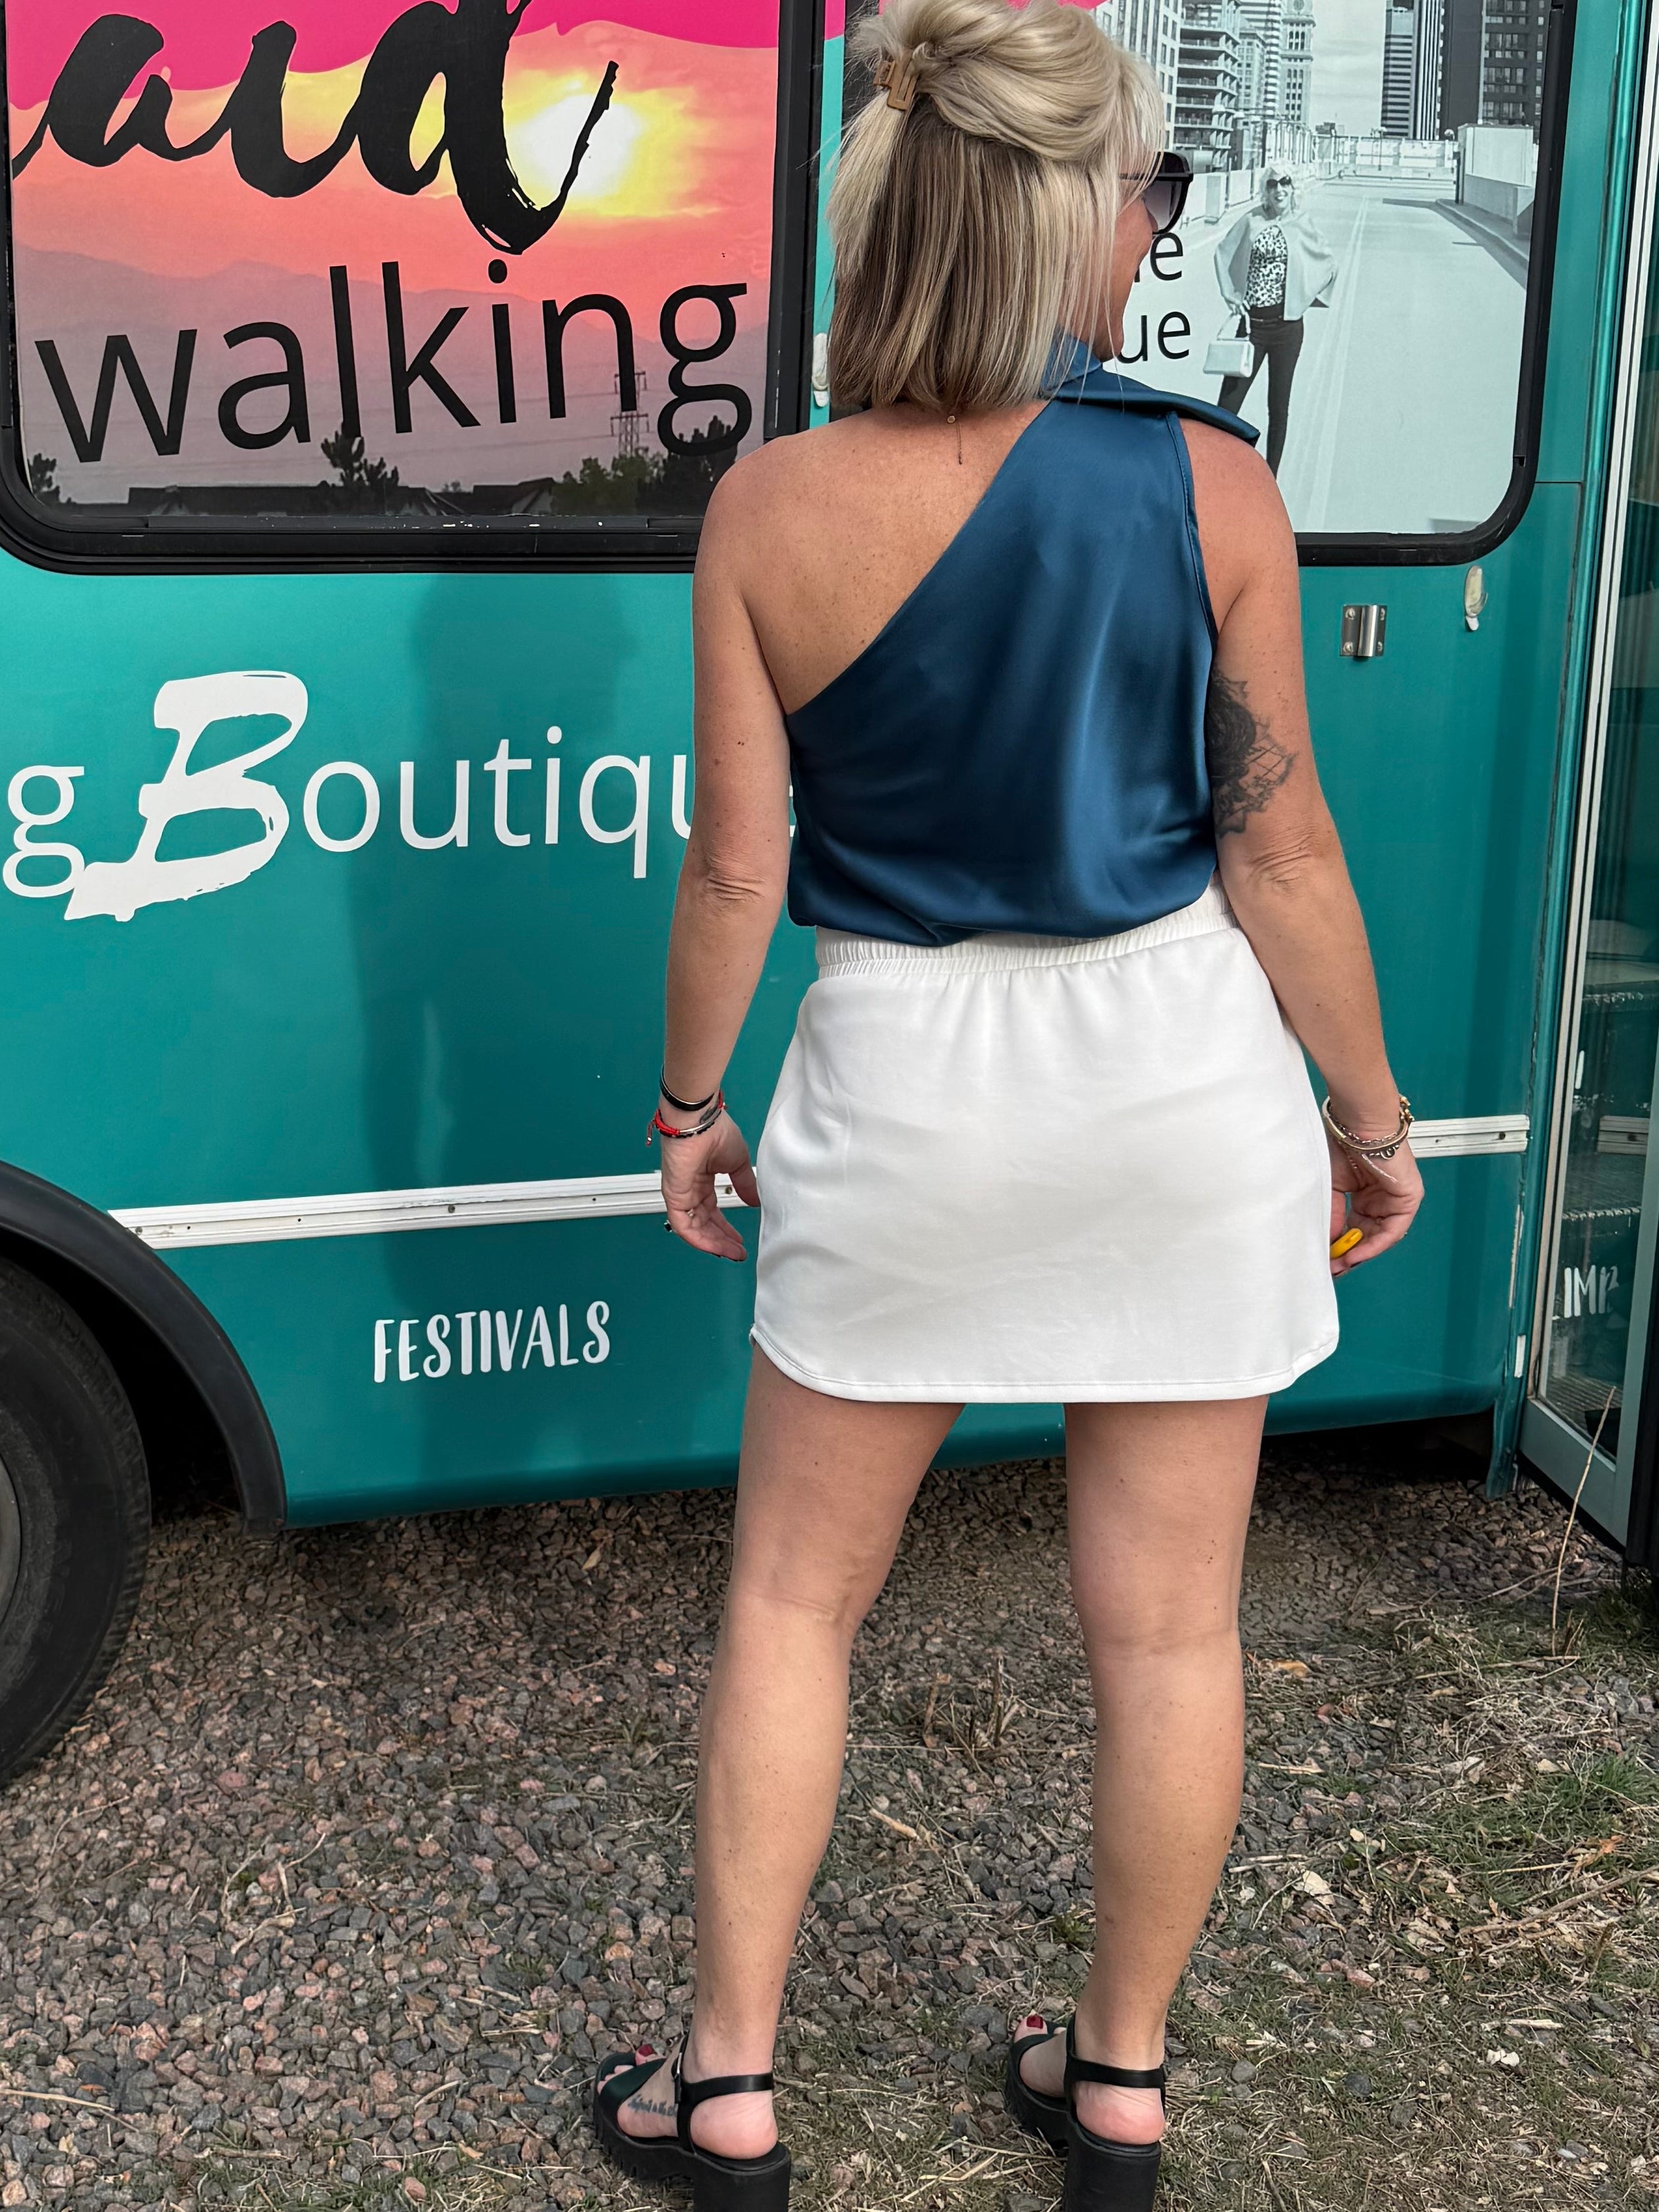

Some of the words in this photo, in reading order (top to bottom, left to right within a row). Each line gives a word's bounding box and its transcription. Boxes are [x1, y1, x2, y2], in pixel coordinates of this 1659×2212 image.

[34, 259, 753, 463] walking
[64, 670, 795, 922] Boutiq
[373, 1300, 611, 1383] FESTIVALS
